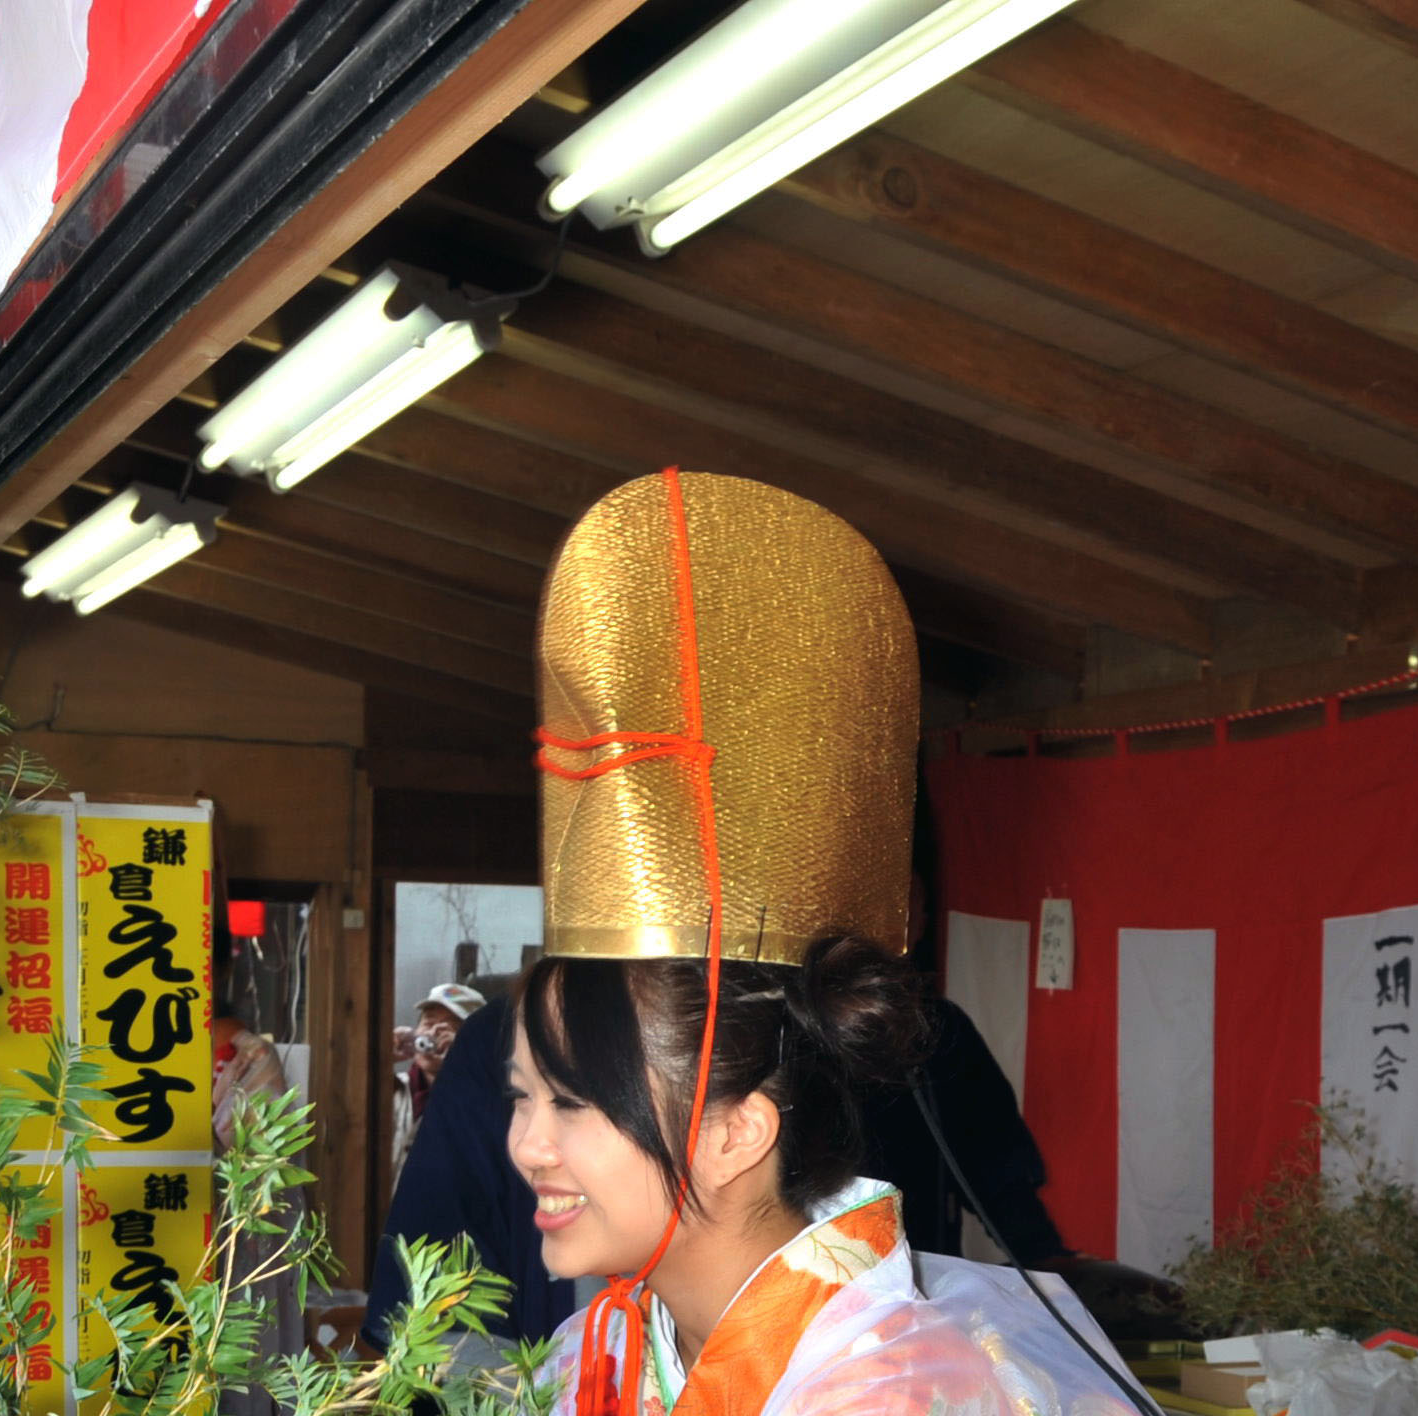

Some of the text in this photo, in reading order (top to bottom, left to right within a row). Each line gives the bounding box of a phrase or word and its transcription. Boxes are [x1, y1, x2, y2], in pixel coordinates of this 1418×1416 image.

[4, 861, 53, 1035] 開運招福
[95, 826, 200, 1143] 鎌倉えびす
[1372, 935, 1415, 1093] 一期一会
